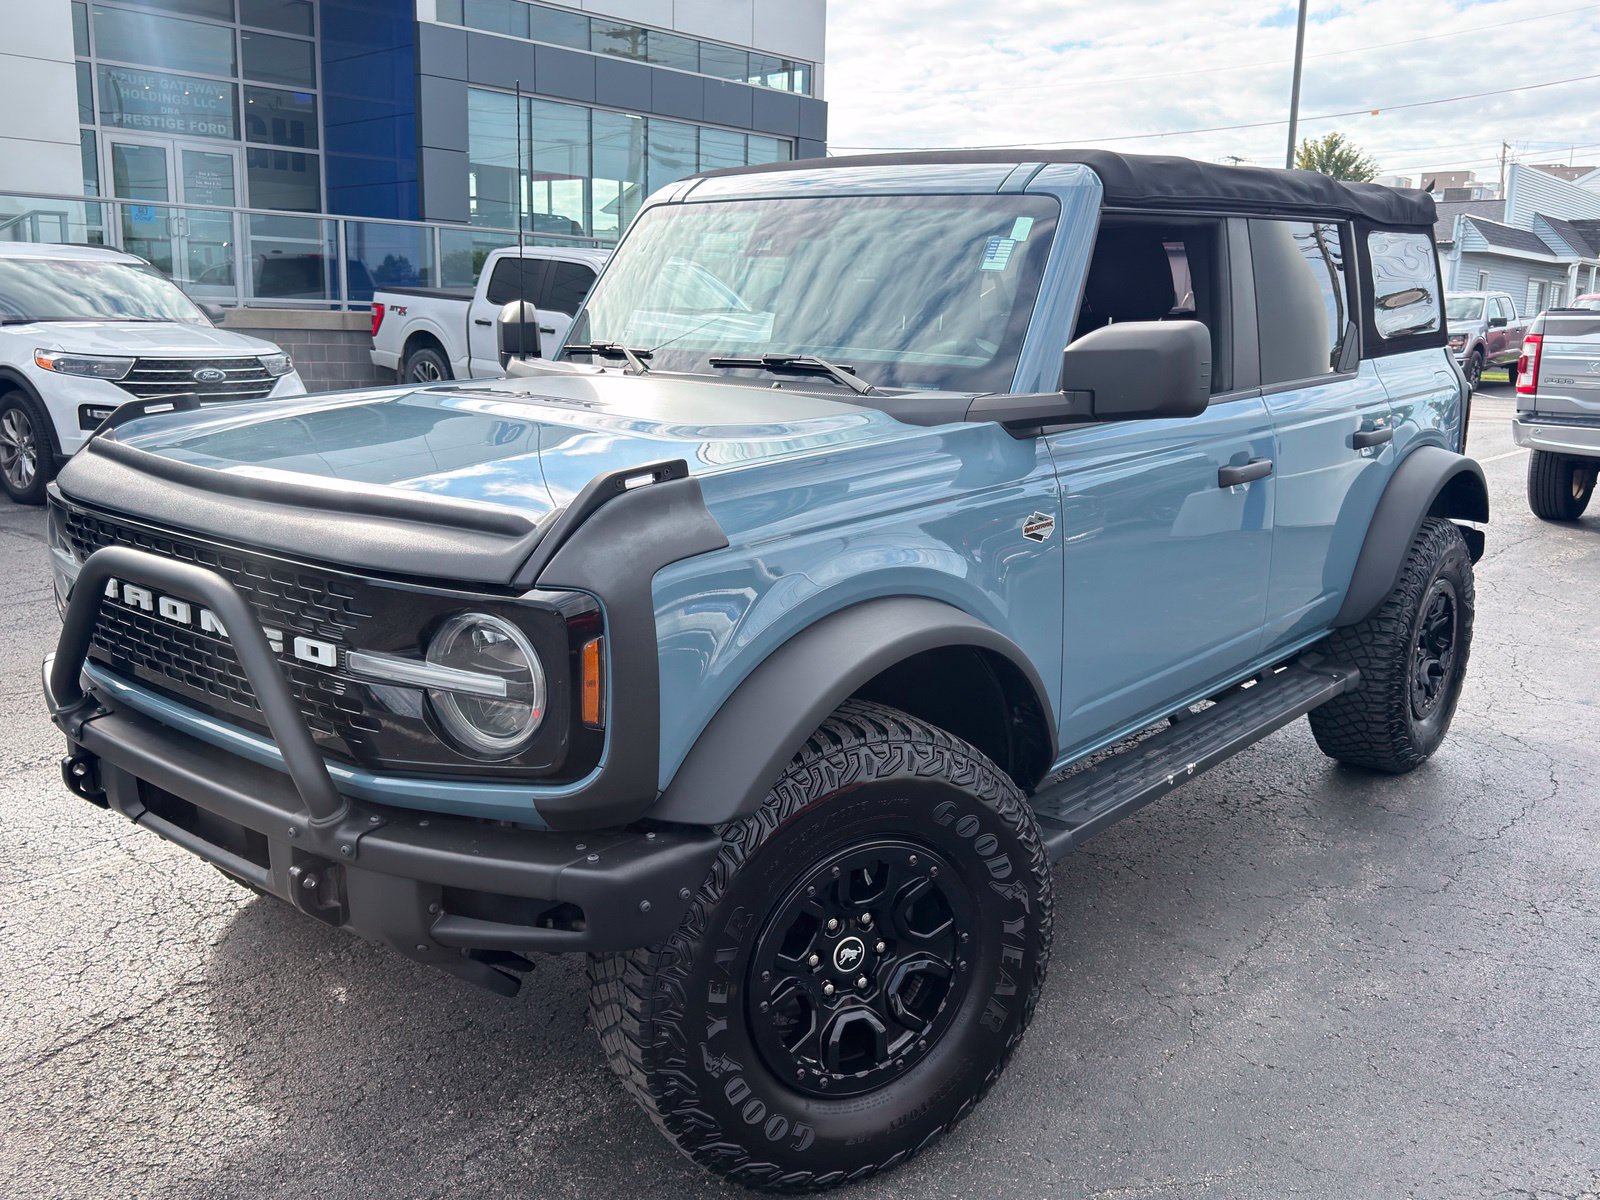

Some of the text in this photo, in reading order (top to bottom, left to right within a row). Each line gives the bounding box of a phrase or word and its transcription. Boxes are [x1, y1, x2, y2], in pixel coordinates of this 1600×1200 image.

[160, 78, 221, 96] GATEWAY
[120, 88, 217, 109] HOLDINGS LLC
[113, 113, 227, 135] PRESTIGE FORD
